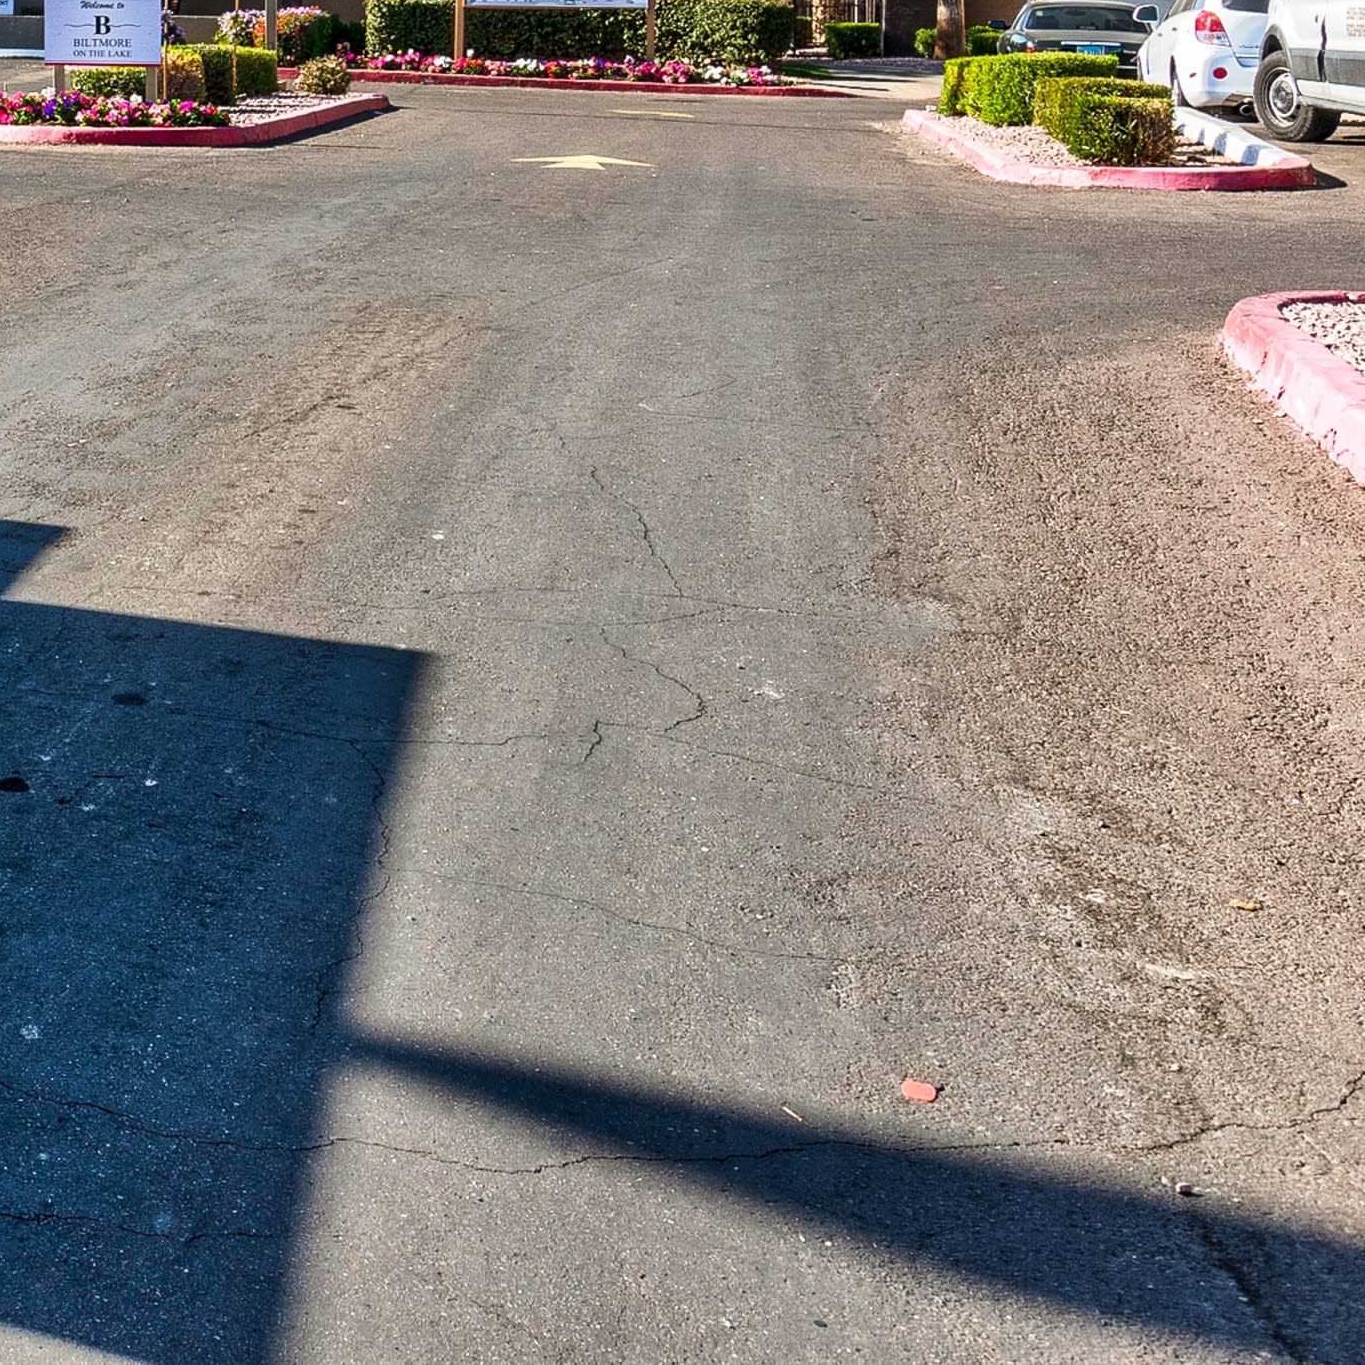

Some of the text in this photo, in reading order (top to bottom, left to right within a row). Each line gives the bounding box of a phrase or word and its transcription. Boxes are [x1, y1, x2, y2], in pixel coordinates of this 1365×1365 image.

[80, 0, 125, 9] Welcome to
[93, 15, 111, 35] B
[73, 38, 133, 47] BILTMORE
[73, 49, 133, 58] ON THE LAKE
